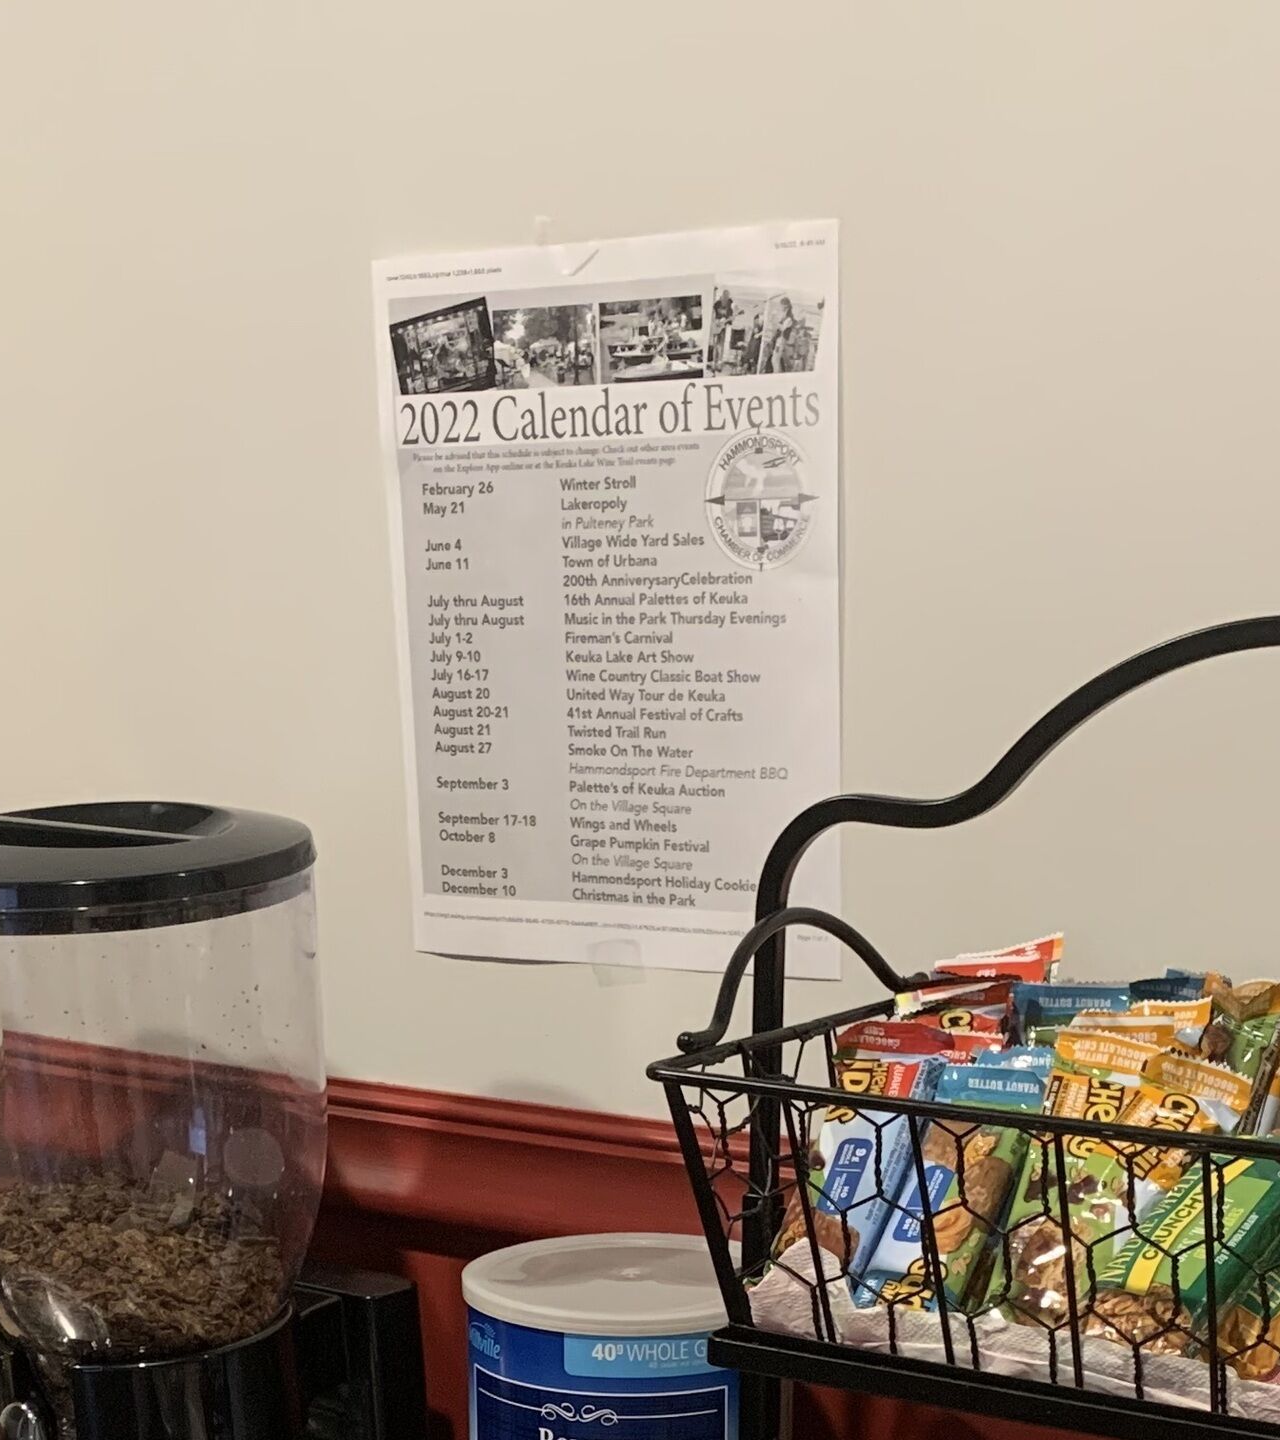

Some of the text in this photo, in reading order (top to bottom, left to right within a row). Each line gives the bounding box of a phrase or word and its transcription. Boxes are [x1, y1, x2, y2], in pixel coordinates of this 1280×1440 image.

[400, 383, 820, 445] 2022 Calendar of Events
[719, 436, 802, 470] HAMMONDSPORT
[421, 480, 494, 499] February 26
[559, 475, 636, 491] Winter Stroll
[422, 500, 464, 518] May 21
[560, 495, 627, 514] Lakeropoly
[424, 538, 462, 552] June 4
[561, 532, 704, 553] Village Wide Yard Sales
[715, 516, 751, 559] CHAMBER
[424, 557, 469, 571] June 11
[562, 553, 657, 568] Town of Urbana
[562, 574, 597, 587] 200th
[426, 594, 524, 611] July thru August
[563, 591, 748, 606] 16th Annual Palettes of Keuka
[564, 611, 786, 628] Music in the Park Thursday Evenings
[428, 632, 473, 647] July 1-2
[623, 631, 673, 644] Carnival
[429, 650, 481, 666] July 9-10
[565, 650, 694, 663] Keuka Lake Art Show
[430, 669, 489, 684] July 16-17
[565, 669, 760, 686] Wine Country Classic Boat Show
[431, 687, 490, 703] August 20
[566, 688, 725, 705] United Way Tour de Keuka
[432, 705, 508, 721] August 20-21
[566, 706, 743, 722] 41st Annual Festival of Crafts
[433, 723, 490, 739] August 21
[567, 725, 666, 739] Twisted Trail Run
[434, 741, 492, 757] August 27
[567, 743, 693, 758] Smoke On The Water
[569, 762, 788, 783] Hammondsport Fire Department BBQ
[436, 776, 509, 793] September 3
[621, 781, 634, 794] of
[637, 782, 675, 796] Keuka
[678, 783, 725, 797] Auction
[438, 812, 536, 828] September 17-18
[569, 816, 677, 833] Wings and Wheels
[438, 829, 495, 843] October 8
[570, 834, 708, 852] Grape Pumpkin Festival
[440, 864, 508, 879] December 3
[441, 881, 516, 897] December 10
[571, 870, 756, 892] Hammondsport Holiday Cookie
[571, 887, 696, 907] Christmas in the Park
[626, 1341, 688, 1361] WHOLE
